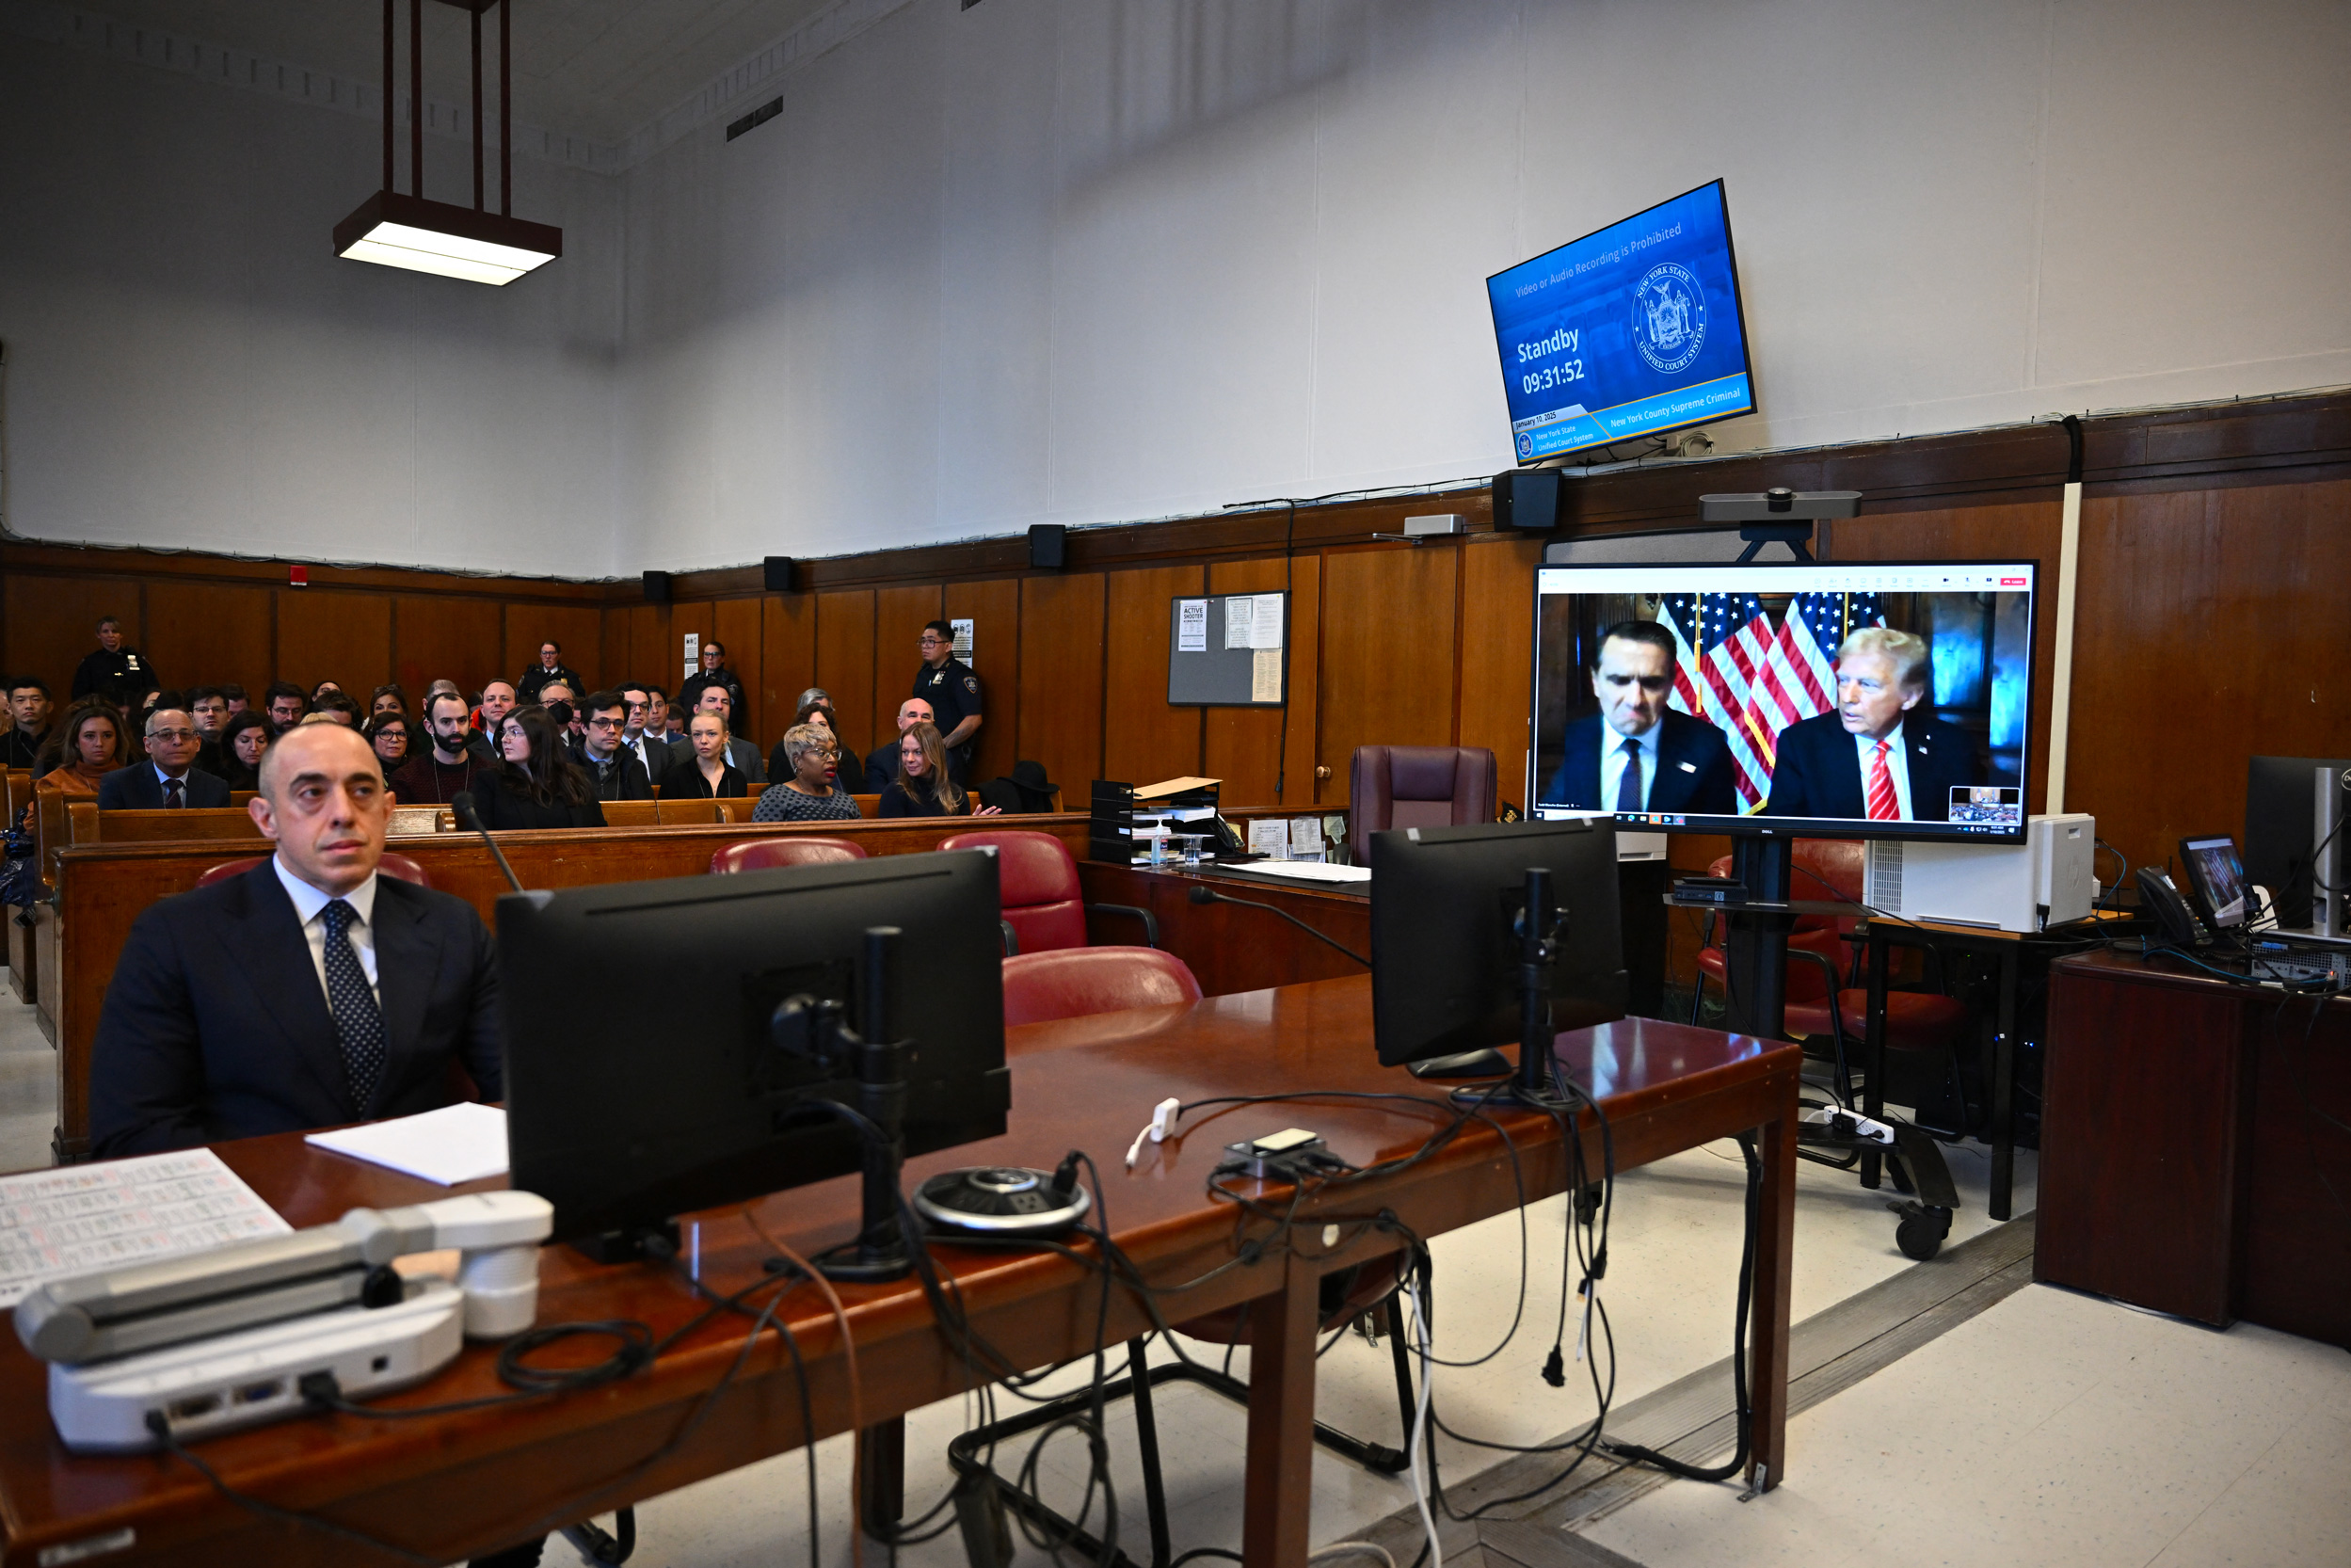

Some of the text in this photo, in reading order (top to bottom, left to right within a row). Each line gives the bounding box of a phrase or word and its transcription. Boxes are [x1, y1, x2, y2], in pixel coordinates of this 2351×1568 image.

[1515, 221, 1682, 298] Video or Audio Recording is Prohibited
[1638, 266, 1690, 298] NEW YORK STATE
[1517, 328, 1578, 363] Standby
[1639, 322, 1704, 371] UNIFIED COURT SYSTEM
[1523, 359, 1585, 394] 09:31:52
[1515, 418, 1535, 430] January
[1544, 412, 1557, 421] 2025
[1610, 387, 1740, 428] New York County Supreme Criminal
[1536, 425, 1575, 440] New York State
[1538, 433, 1593, 452] Unified Court System
